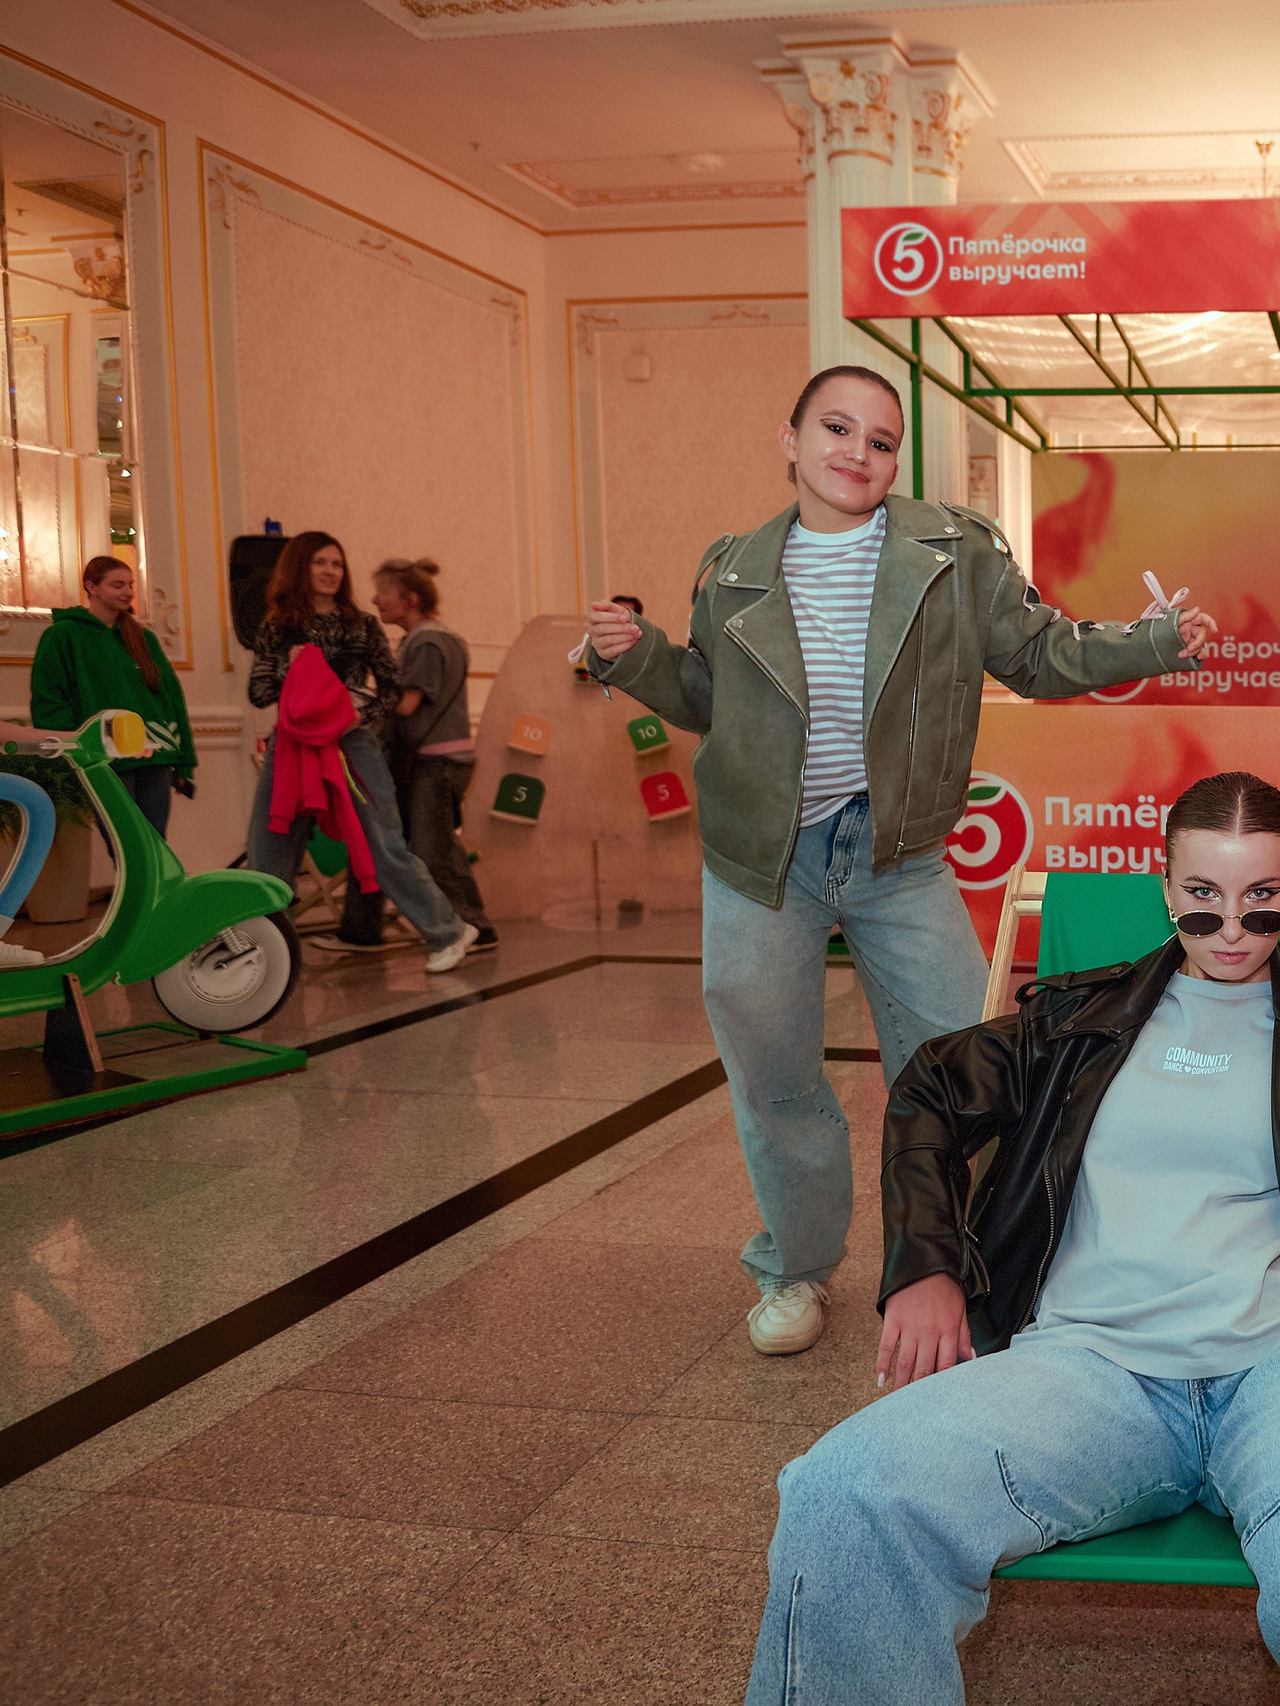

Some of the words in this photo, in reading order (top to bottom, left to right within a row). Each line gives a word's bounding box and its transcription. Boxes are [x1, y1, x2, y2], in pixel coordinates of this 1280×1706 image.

[948, 234, 1086, 257] Пятёрочка
[949, 261, 1086, 285] выручает!
[523, 725, 543, 741] 10
[637, 724, 658, 740] 10
[514, 785, 528, 803] 5
[656, 783, 670, 801] 5
[1166, 1047, 1232, 1067] COMMUNITY
[1163, 1060, 1184, 1073] DANCE
[1191, 1065, 1230, 1075] CONVENTION
